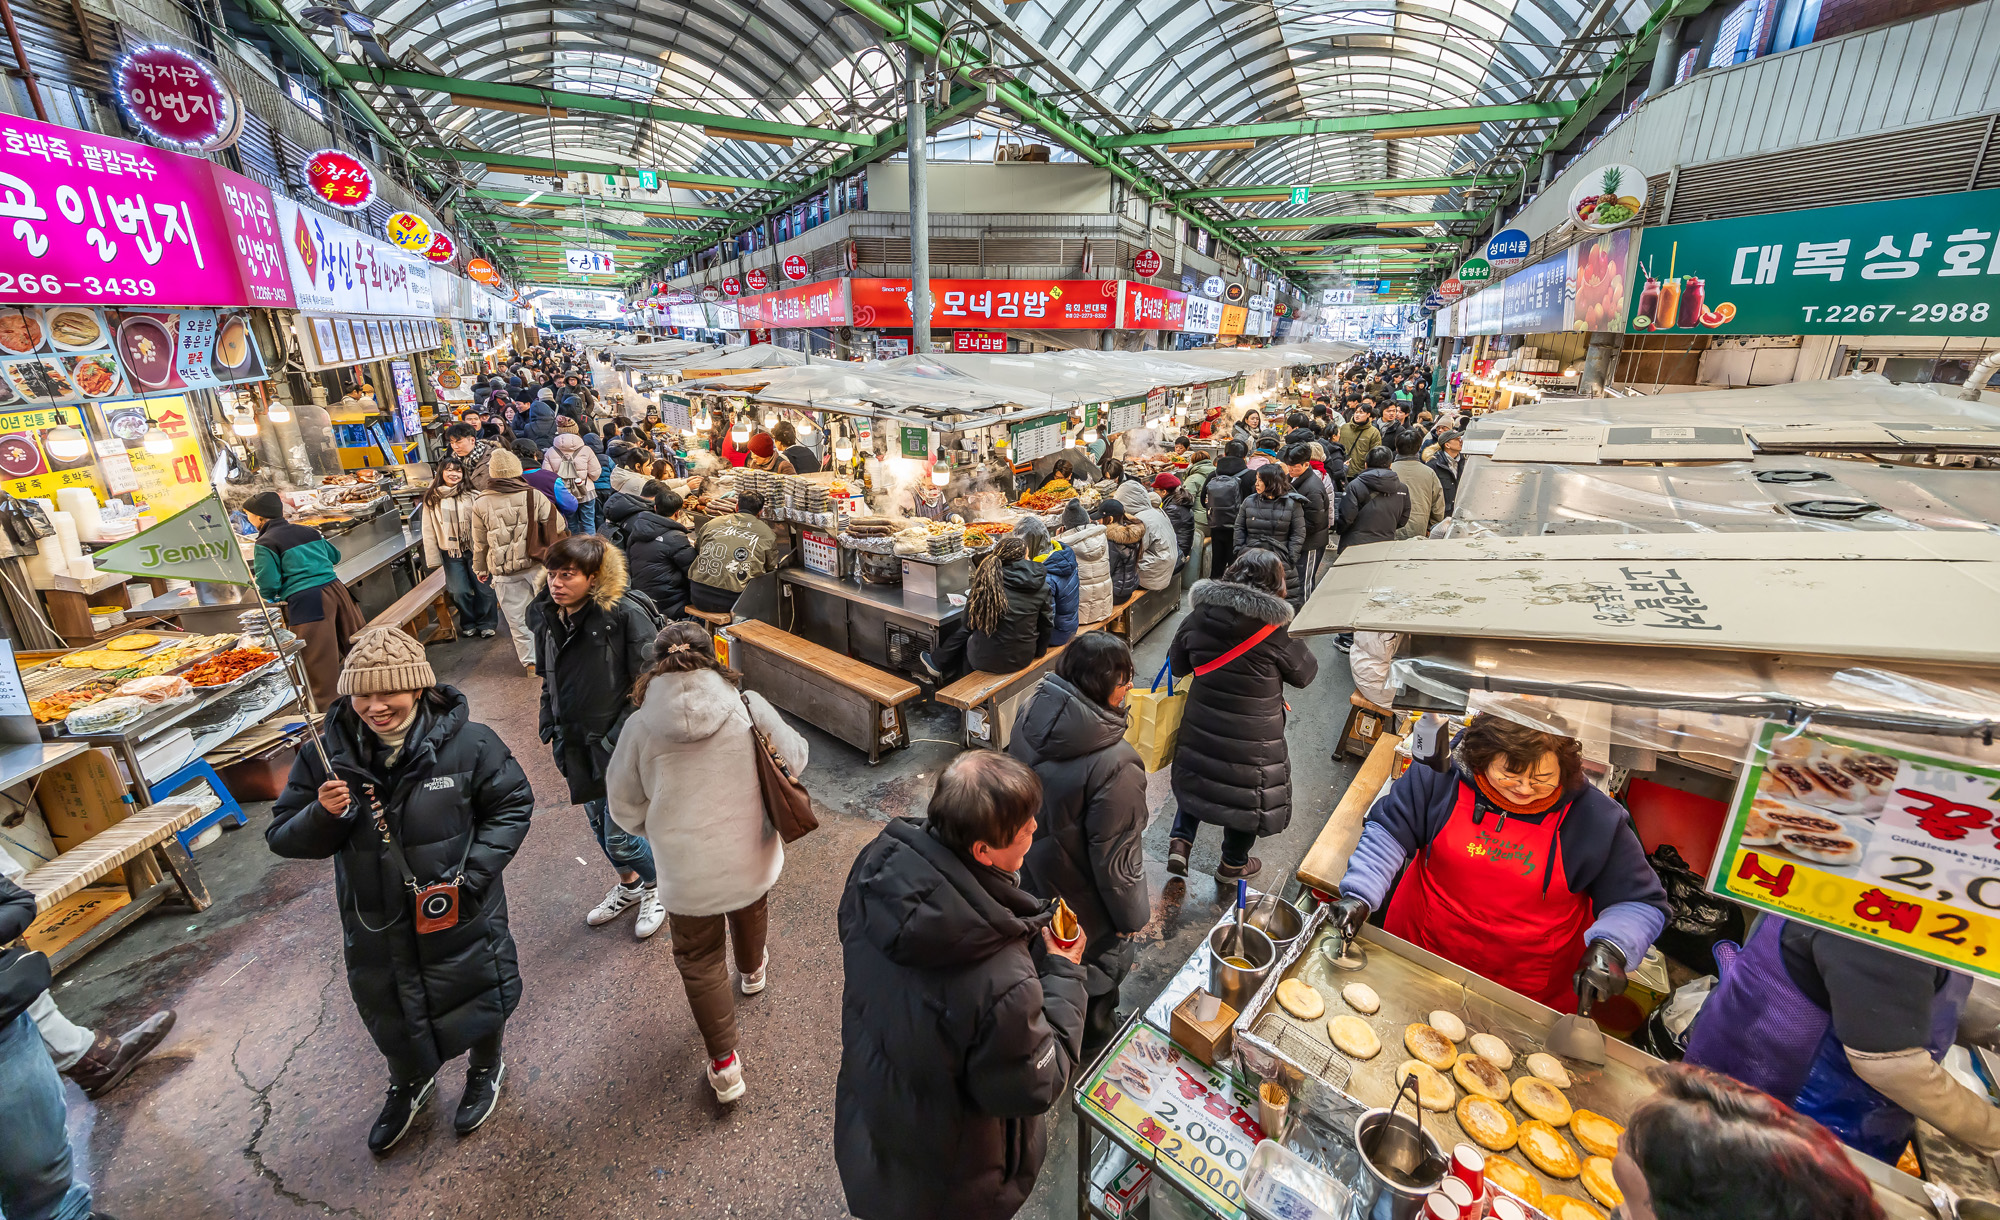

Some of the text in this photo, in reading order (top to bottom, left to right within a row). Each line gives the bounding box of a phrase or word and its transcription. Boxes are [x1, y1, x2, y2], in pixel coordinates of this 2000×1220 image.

[135, 62, 200, 87] 먹자골
[132, 88, 217, 125] 일번지
[326, 162, 367, 182] 창신
[321, 183, 362, 200] 육회
[222, 182, 273, 237] 먹자골
[56, 185, 205, 271] 일번지
[402, 218, 413, 228] 신
[396, 230, 428, 245] 창신
[1490, 240, 1528, 255] 성미식품
[236, 234, 286, 281] 일번지
[1135, 260, 1160, 268] 모녀김밥
[1731, 228, 2000, 285] 대복상회
[786, 265, 806, 275] 빈대떡
[1461, 266, 1489, 277] 동명홍삼
[1441, 281, 1463, 294] 신안상회
[1515, 271, 1544, 313] 성미식품
[778, 297, 800, 320] 모녀김밥
[942, 290, 1050, 319] 모녀김밥
[1142, 298, 1163, 319] 모녀김밥
[1802, 302, 1990, 323] T.2267-2988
[187, 318, 212, 333] 오늘은
[183, 334, 212, 349] 좋은 날
[958, 338, 1004, 350] 모녀김밥
[188, 351, 203, 365] 팥죽
[180, 366, 212, 380] 먹는 날
[24, 413, 46, 427] 전통
[62, 470, 93, 485] 호박죽
[139, 539, 230, 568] Jenny
[1891, 834, 1968, 858] Griddlecake
[1466, 842, 1536, 876] 육회 빈대떡
[1728, 884, 1753, 897] Sweet
[1756, 892, 1776, 904] Rice
[1777, 898, 1807, 914] Punch
[1155, 1101, 1248, 1171] 2,000
[1163, 1137, 1241, 1201] 2,000
